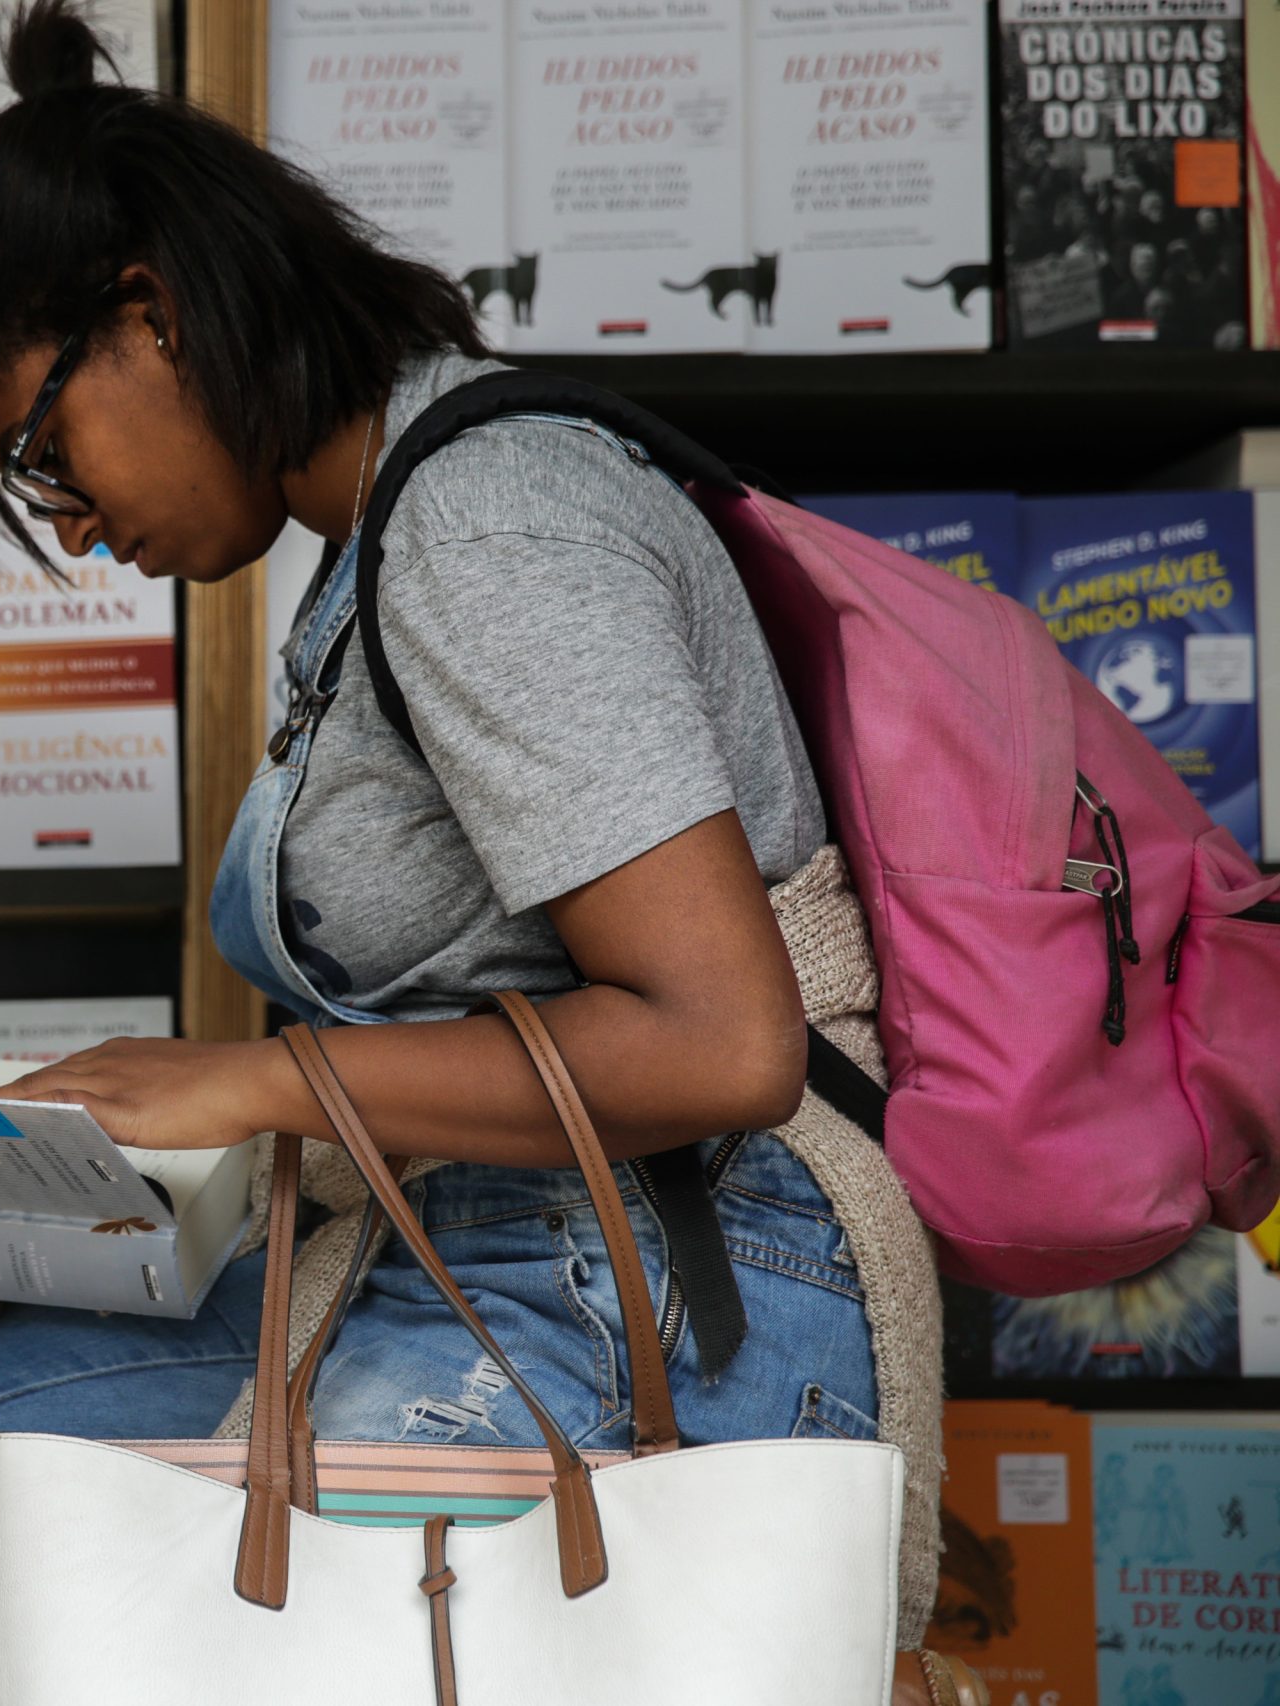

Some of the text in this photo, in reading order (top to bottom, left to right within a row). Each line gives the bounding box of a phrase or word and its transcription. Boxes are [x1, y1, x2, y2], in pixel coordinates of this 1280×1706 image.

[1020, 20, 1227, 64] CRÓNICAS
[306, 52, 464, 84] ILUDIDOS
[542, 52, 701, 86] ILUDIDOS
[782, 47, 944, 85] ILUDIDOS
[1026, 63, 1221, 101] DOS DIAS
[340, 84, 429, 114] PELO
[577, 84, 666, 115] PELO
[818, 82, 908, 114] PELO
[331, 115, 438, 145] ACASO
[568, 116, 674, 147] ACASO
[806, 114, 916, 146] ACASO
[1042, 101, 1207, 138] DO LIXO
[1051, 537, 1136, 572] STEPHEN
[1159, 518, 1208, 547] KING
[1037, 550, 1227, 618] LAMENTÁVEL
[1147, 578, 1234, 624] NOVO
[1065, 869, 1089, 881] ASTPAK
[1118, 1567, 1280, 1599] LITERAT
[1132, 1601, 1182, 1630] DE
